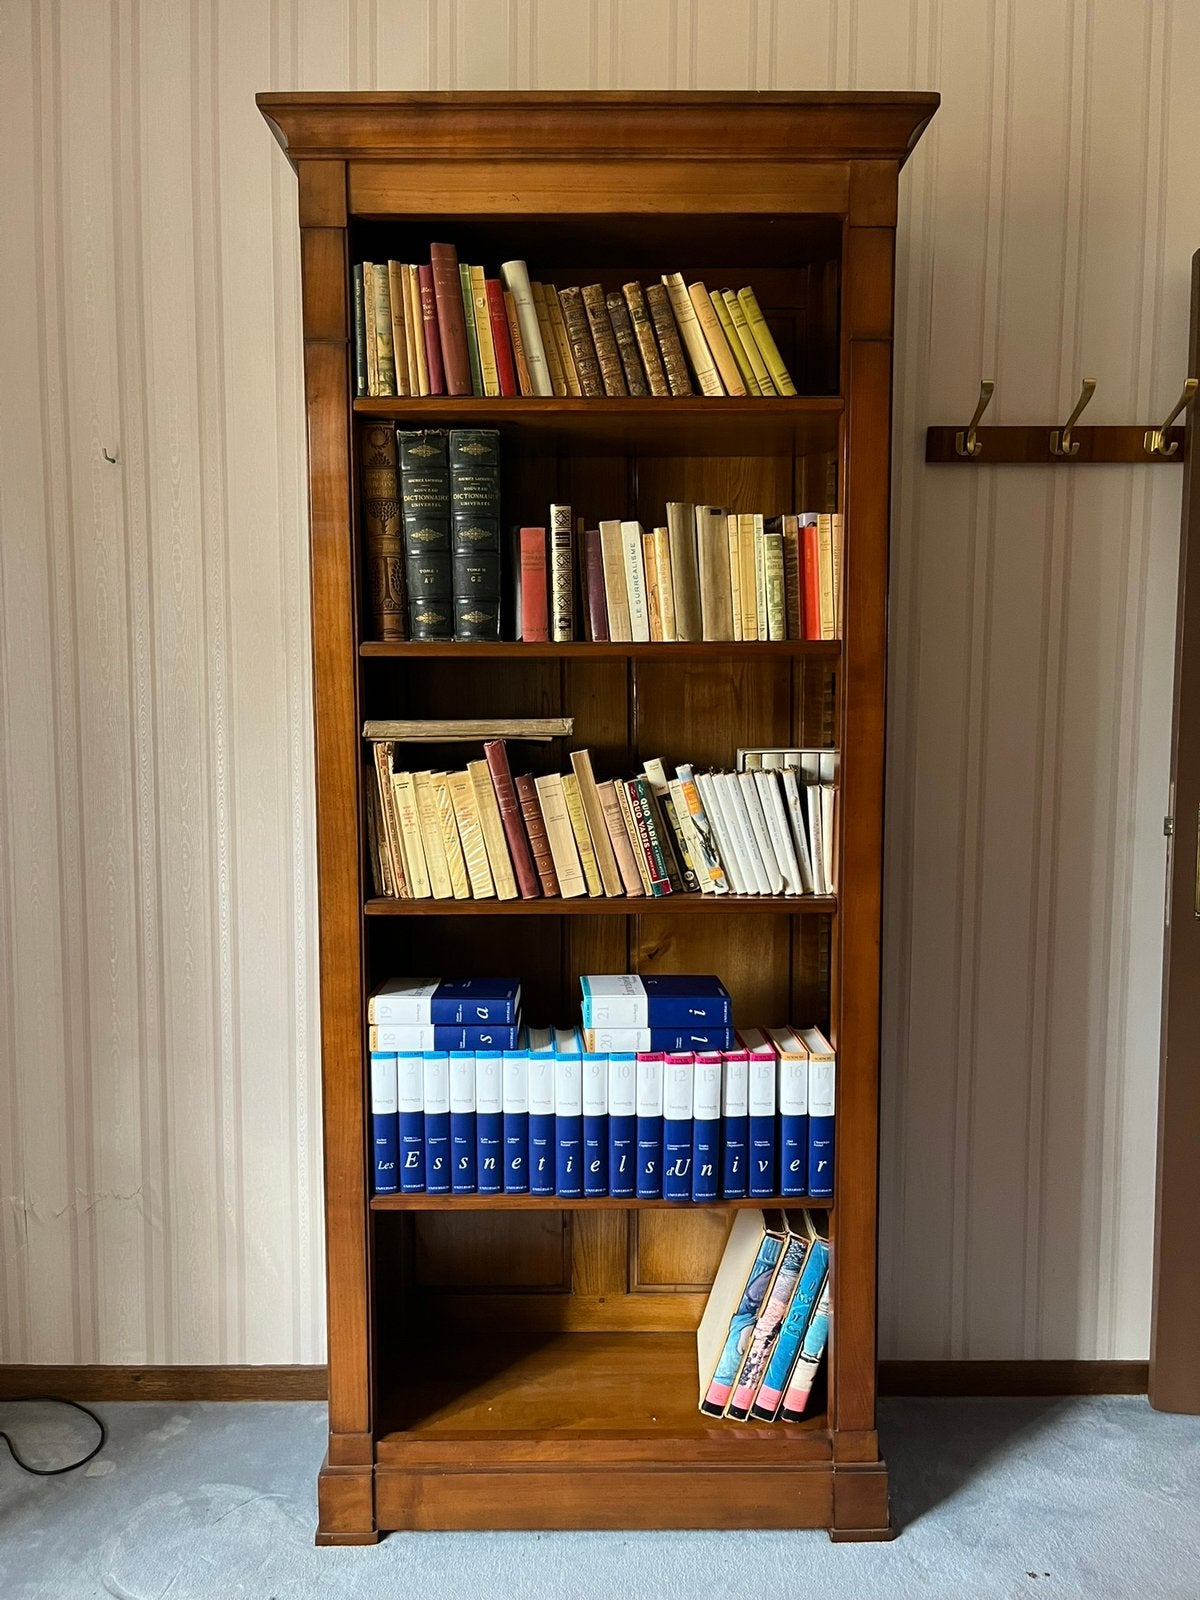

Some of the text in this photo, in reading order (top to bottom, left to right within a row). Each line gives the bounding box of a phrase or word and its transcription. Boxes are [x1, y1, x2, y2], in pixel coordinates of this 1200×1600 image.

[404, 494, 449, 502] DICTIONNAIRE
[630, 543, 643, 618] LE SURRÉALISME
[633, 800, 643, 819] QUO
[638, 821, 651, 849] VADIS
[640, 798, 651, 817] QUO
[646, 819, 658, 846] VADIS
[476, 1007, 489, 1019] a
[597, 1005, 610, 1021] 21
[688, 1009, 706, 1017] i
[383, 1032, 396, 1047] 18
[480, 1034, 493, 1044] s
[600, 1033, 612, 1050] 20
[407, 1063, 417, 1076] 2
[432, 1063, 441, 1077] 3
[458, 1063, 468, 1075] 4
[485, 1063, 494, 1076] 6
[512, 1063, 520, 1077] 5
[538, 1064, 547, 1078] 7
[564, 1066, 573, 1079] 8
[591, 1065, 600, 1078] 9
[616, 1067, 631, 1078] 10
[644, 1067, 657, 1079] 11
[672, 1069, 688, 1082] 12
[702, 1069, 716, 1081] 13
[730, 1067, 743, 1080] 14
[756, 1067, 770, 1079] 15
[788, 1065, 802, 1078] 16
[815, 1067, 831, 1079] 17
[378, 1160, 394, 1170] Les
[405, 1151, 420, 1168] E
[433, 1157, 443, 1170] s
[459, 1157, 469, 1169] s
[484, 1157, 496, 1170] n
[511, 1157, 522, 1170] e
[538, 1156, 546, 1171] t
[566, 1156, 573, 1173] i
[732, 1156, 739, 1173] i
[790, 1159, 801, 1172] e
[590, 1160, 601, 1173] e
[645, 1161, 655, 1174] s
[701, 1164, 713, 1177] n
[757, 1160, 769, 1173] v
[817, 1160, 829, 1173] r
